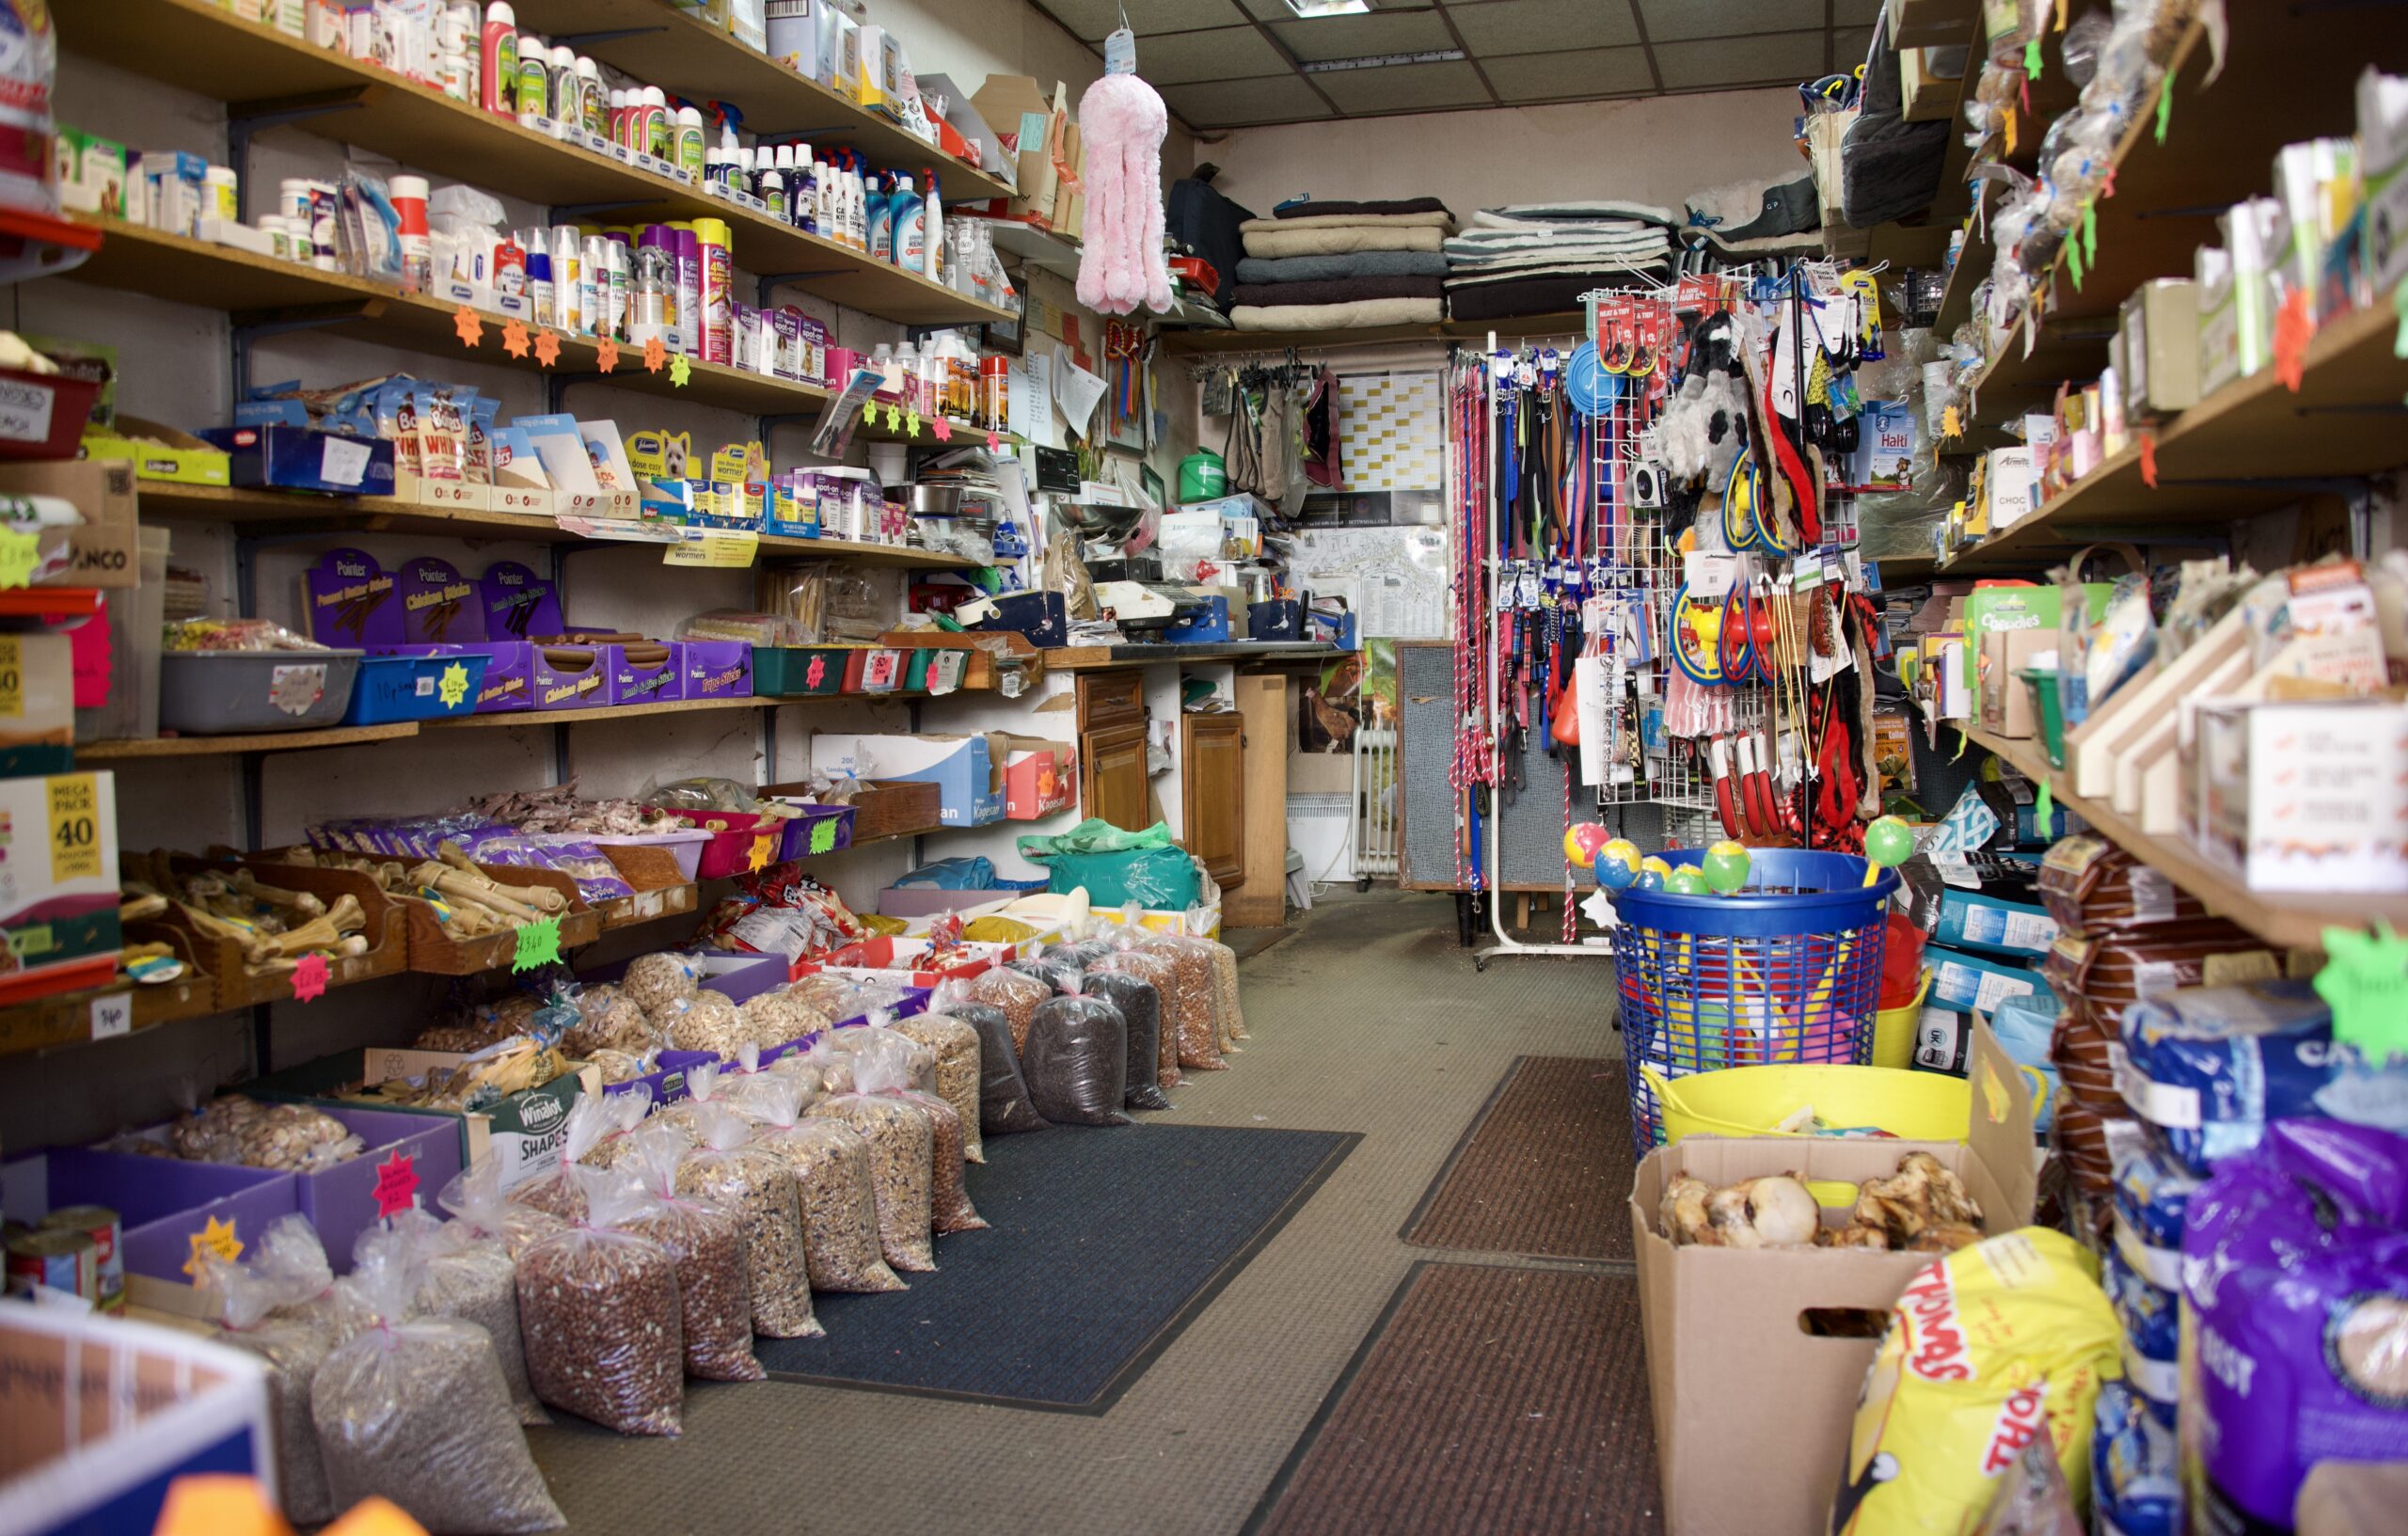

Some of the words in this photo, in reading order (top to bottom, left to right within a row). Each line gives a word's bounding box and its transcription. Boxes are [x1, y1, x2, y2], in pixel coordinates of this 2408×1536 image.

[774, 323, 796, 334] spot-on
[802, 329, 824, 340] spot-on
[1881, 433, 1908, 448] Halti
[717, 467, 743, 477] wormer
[674, 550, 705, 560] wormers
[337, 561, 366, 578] Pointer
[419, 568, 447, 583] Pointer
[369, 577, 393, 593] Sticks
[498, 572, 523, 585] Pointer
[405, 592, 443, 611] Chicken
[444, 583, 470, 601] Sticks
[535, 675, 554, 687] Pointer
[618, 673, 634, 684] Pointer
[690, 669, 706, 679] Pointer
[702, 674, 721, 694] Tripe
[721, 668, 741, 687] Sticks
[504, 676, 524, 692] Sticks
[546, 684, 577, 705] Chicken
[577, 675, 600, 693] Sticks
[940, 806, 958, 818] an
[973, 802, 1000, 819] Kagesan
[1038, 797, 1066, 813] Kagesan
[56, 816, 93, 847] 40
[521, 1122, 568, 1162] SHAPES
